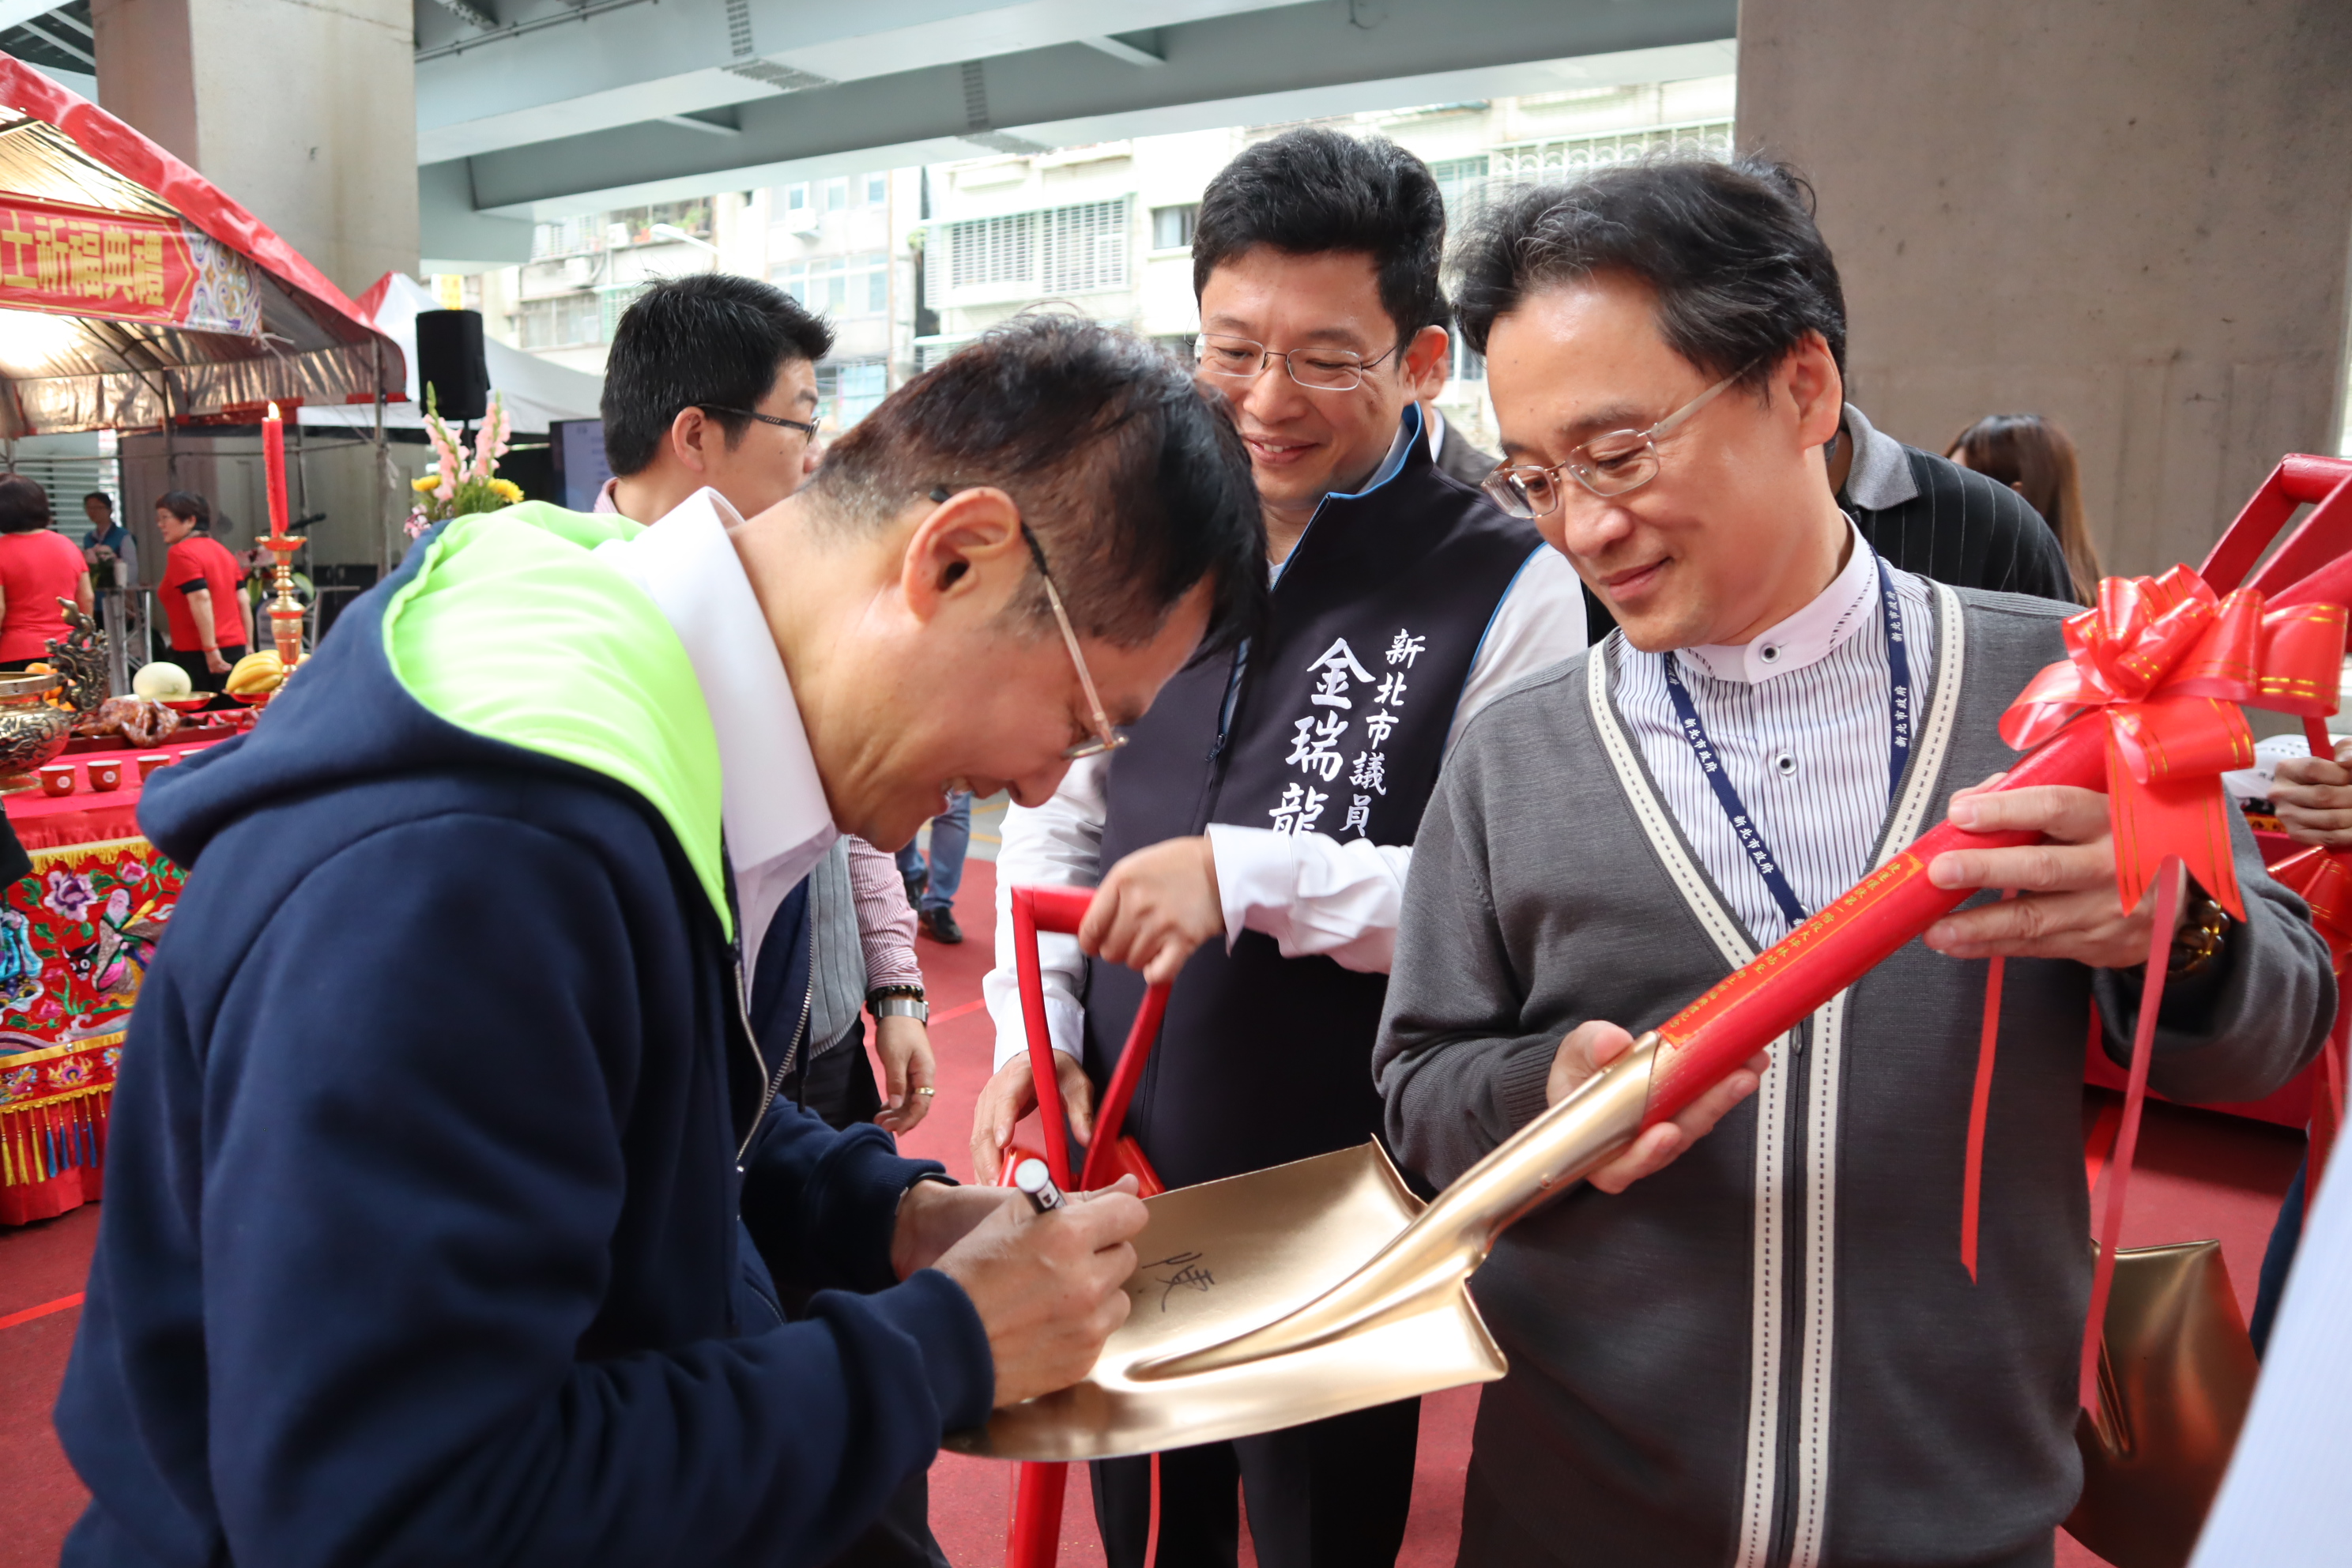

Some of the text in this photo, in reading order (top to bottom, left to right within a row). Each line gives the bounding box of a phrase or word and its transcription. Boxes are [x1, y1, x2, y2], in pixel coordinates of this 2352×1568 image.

[0, 209, 165, 306] 土祈福典禮
[1886, 590, 1904, 643] 新北市政府
[1268, 637, 1376, 839] 金瑞龍
[1339, 628, 1426, 837] 新北市議員
[1684, 718, 1718, 772] 新北市政府
[1894, 685, 1908, 748] 新北市政府
[1733, 815, 1774, 874] 新北市政府
